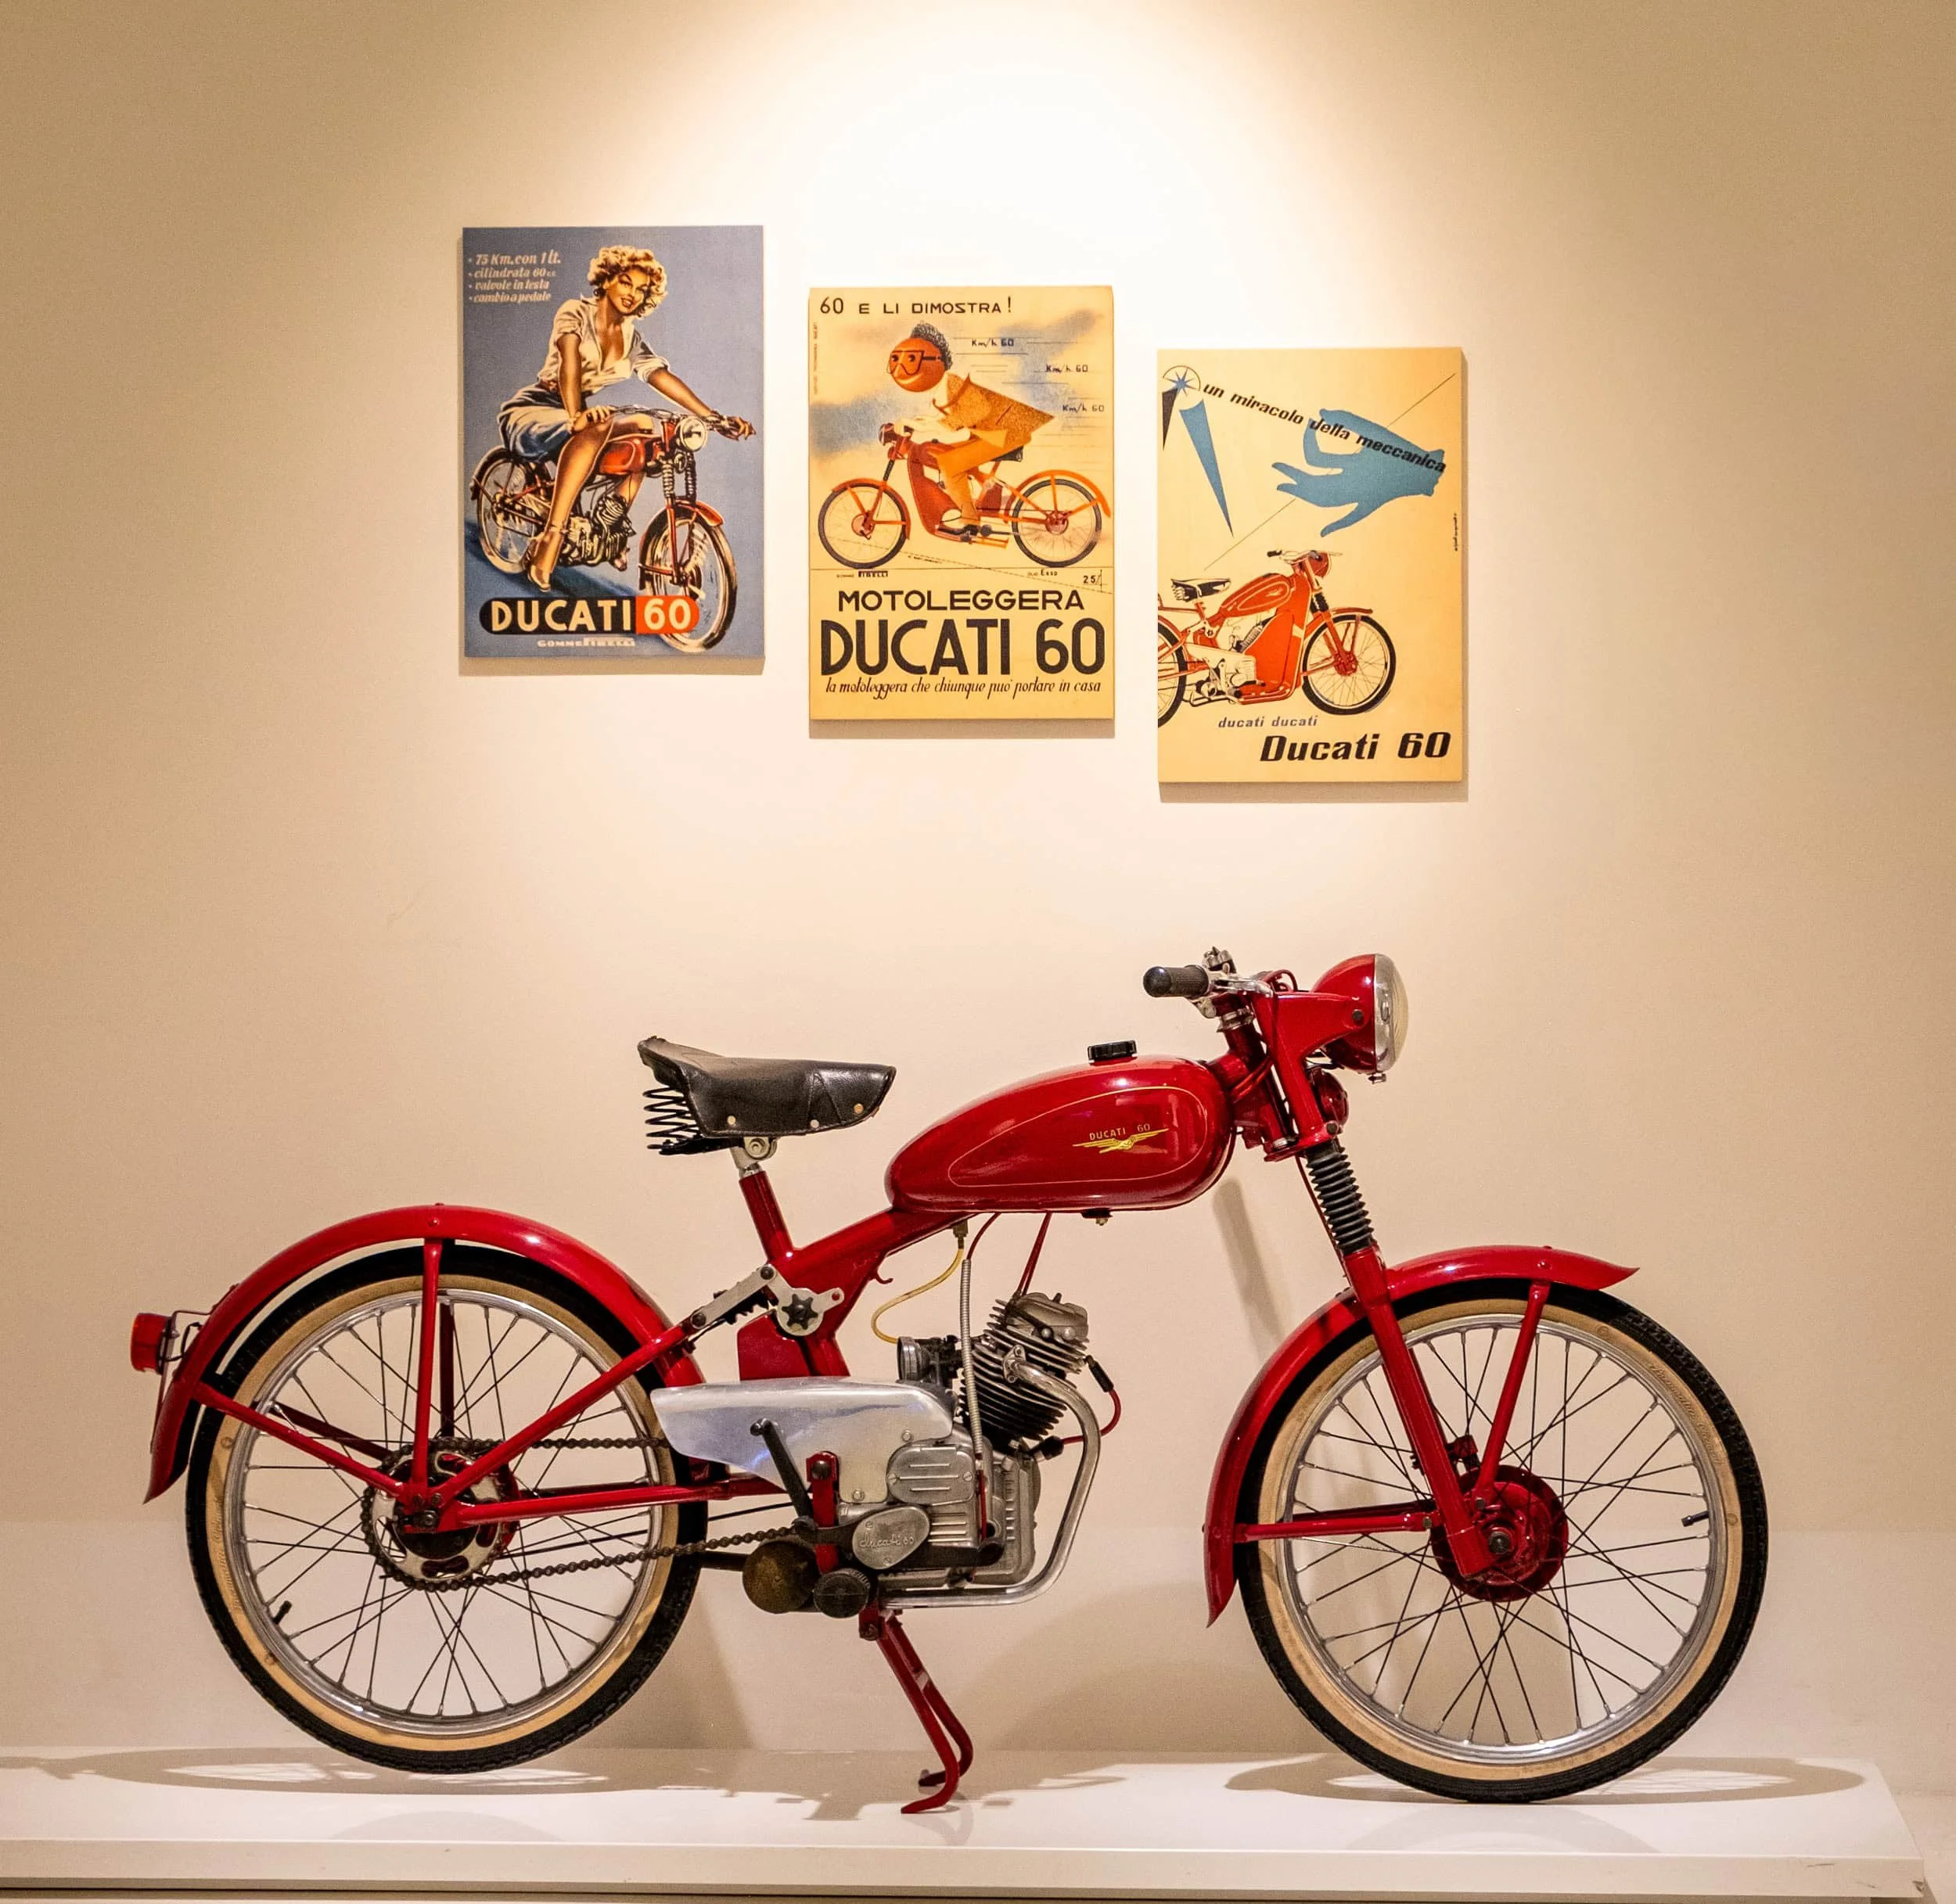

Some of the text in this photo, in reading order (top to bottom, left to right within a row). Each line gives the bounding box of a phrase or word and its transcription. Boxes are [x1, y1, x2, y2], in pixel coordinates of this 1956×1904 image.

[820, 296, 844, 314] 60
[859, 303, 870, 314] E
[883, 303, 899, 314] LI
[971, 338, 1015, 347] Km/h 60
[1045, 363, 1088, 373] Km/h 60
[1062, 404, 1088, 414] Km/h
[1203, 383, 1447, 472] un miracolo della meccanica
[838, 589, 1085, 612] MOTOLEGGERA
[491, 598, 692, 631] DUCATI 60
[821, 616, 1106, 676] DUCATI 60
[825, 677, 836, 693] la
[839, 677, 908, 700] motoleggera
[911, 677, 931, 693] che
[934, 677, 986, 700] chiunque
[1012, 676, 1055, 700] portare
[1059, 679, 1070, 692] in
[1073, 681, 1102, 692] casa
[1217, 715, 1318, 729] ducati ducati
[1259, 731, 1451, 762] Ducati 60
[1088, 1123, 1151, 1141] DUCATI 60
[860, 1531, 901, 1548] ducati
